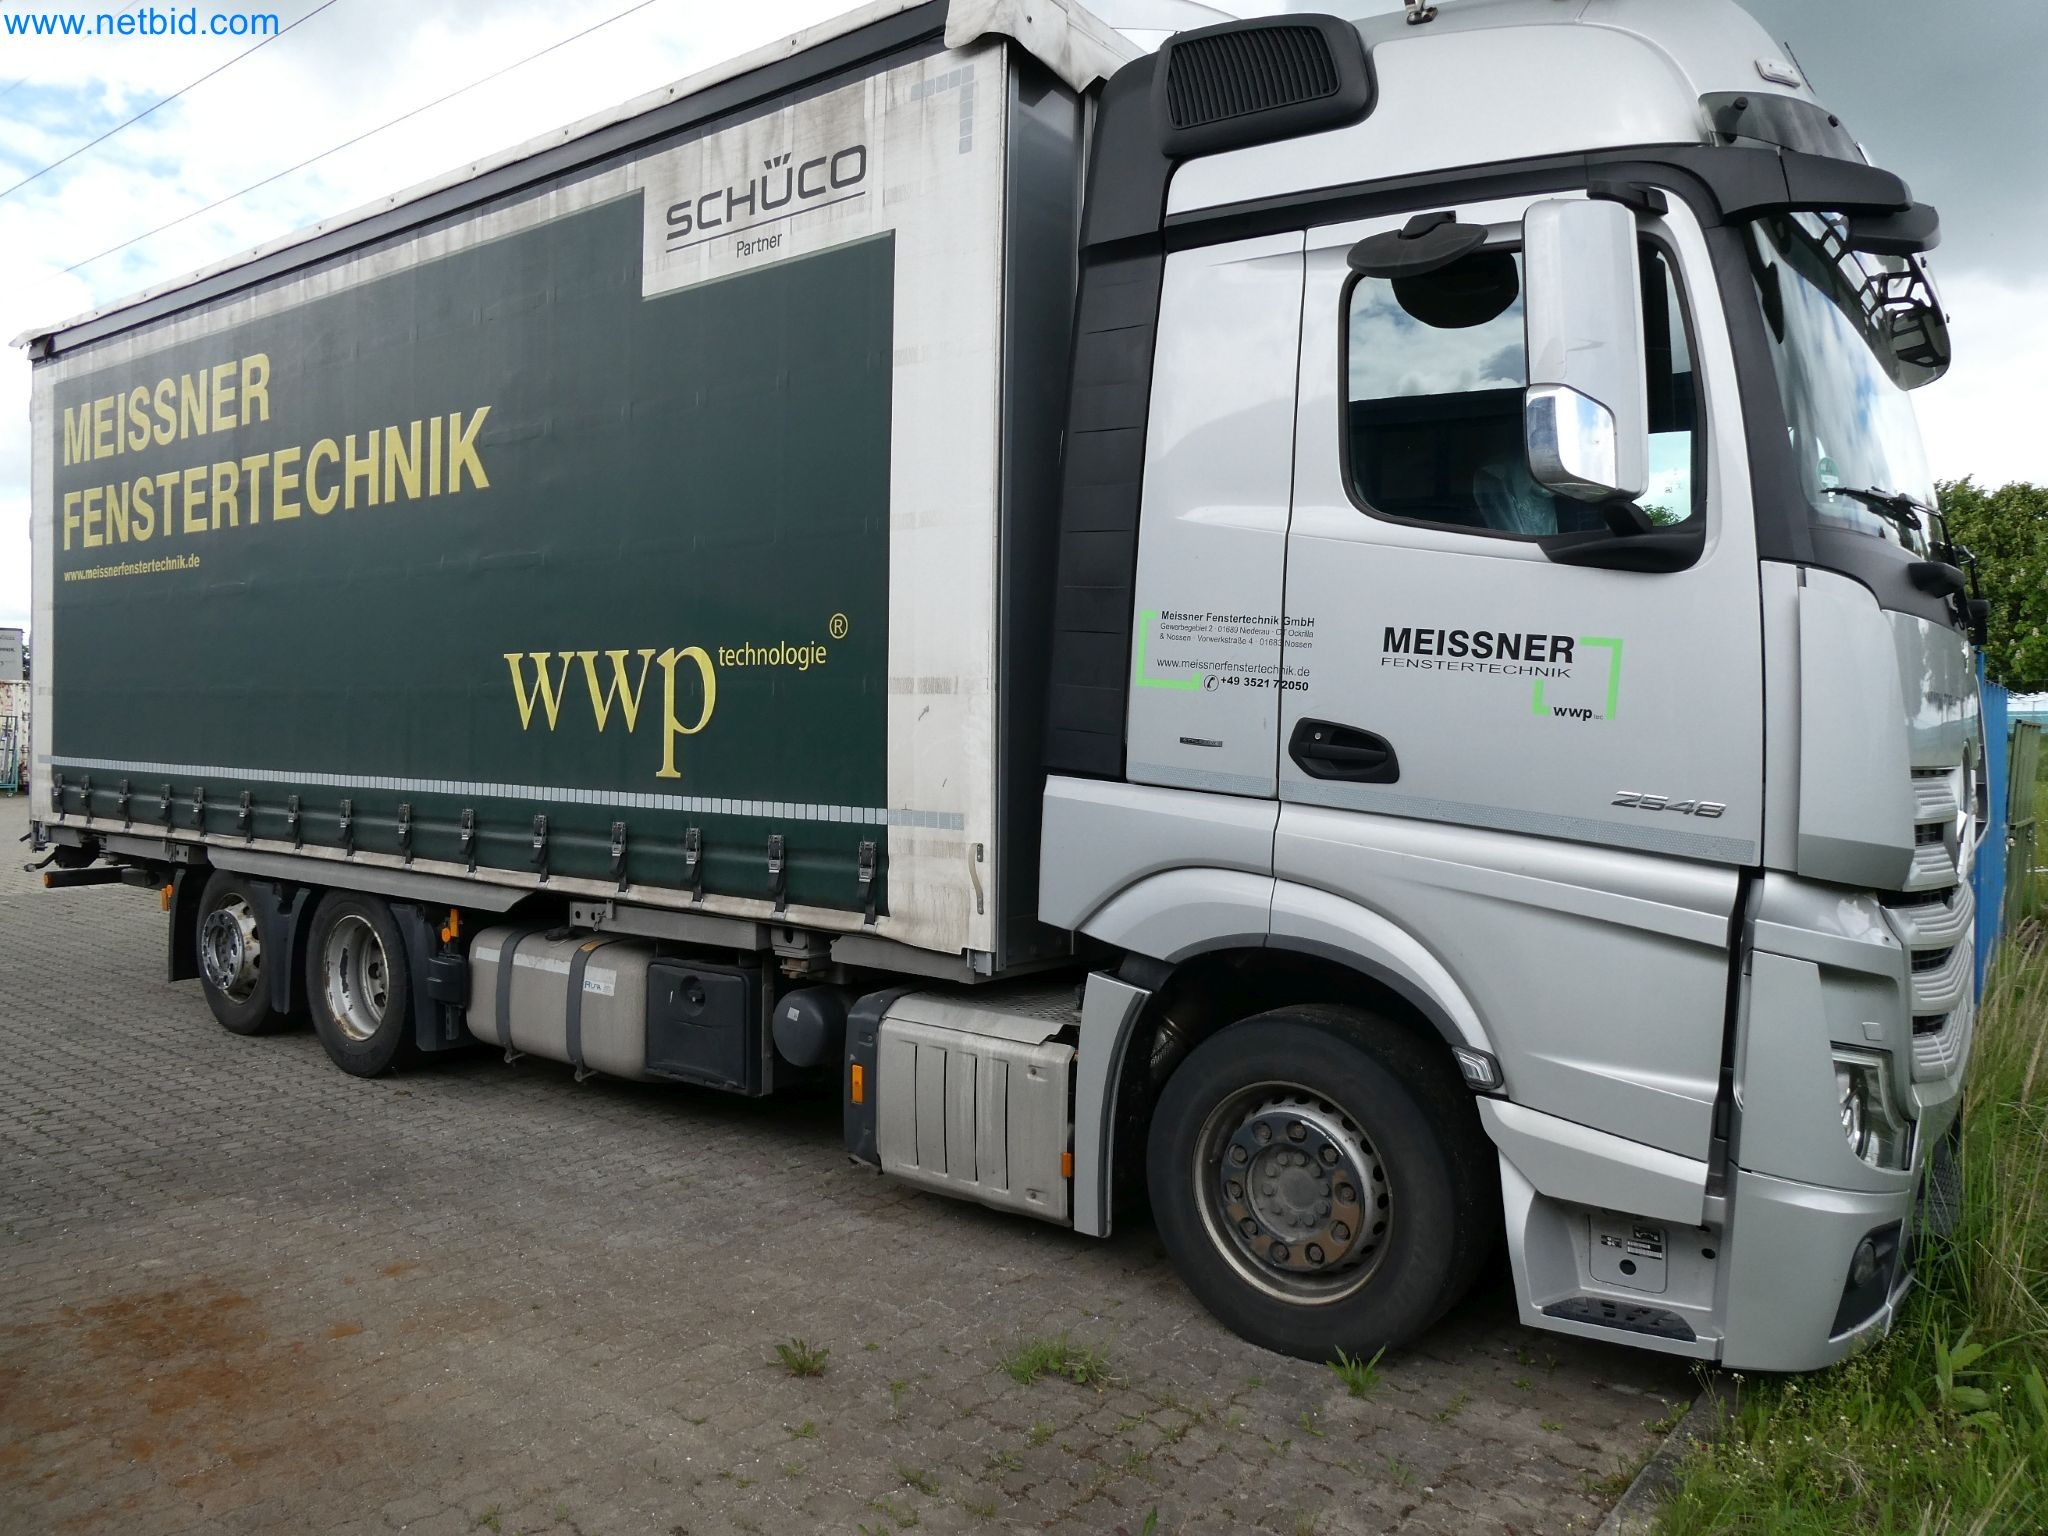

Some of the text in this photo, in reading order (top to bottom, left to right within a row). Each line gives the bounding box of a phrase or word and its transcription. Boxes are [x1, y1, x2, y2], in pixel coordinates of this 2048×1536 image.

[667, 145, 867, 240] SCHÜCO
[736, 233, 782, 258] Partner
[64, 353, 270, 466] MEISSNER
[64, 405, 491, 550] FENSTERTECHNIK
[64, 553, 200, 581] www.meissnerfenstertechnik.de
[1161, 610, 1315, 628] Meissner Fenstertechnik GmbH
[1166, 634, 1191, 642] Nossen
[1284, 640, 1313, 649] Nossen
[1382, 626, 1575, 664] MEISSNER
[1156, 658, 1310, 677] www.meissnerfenstertechnik.de
[1381, 657, 1572, 679] FENSTERTECHNIK
[1220, 676, 1309, 692] +49 3521 72050
[503, 646, 716, 778] wwp
[718, 641, 826, 671] technologie
[1552, 706, 1593, 721] wwp
[1611, 790, 1727, 818] 2548
